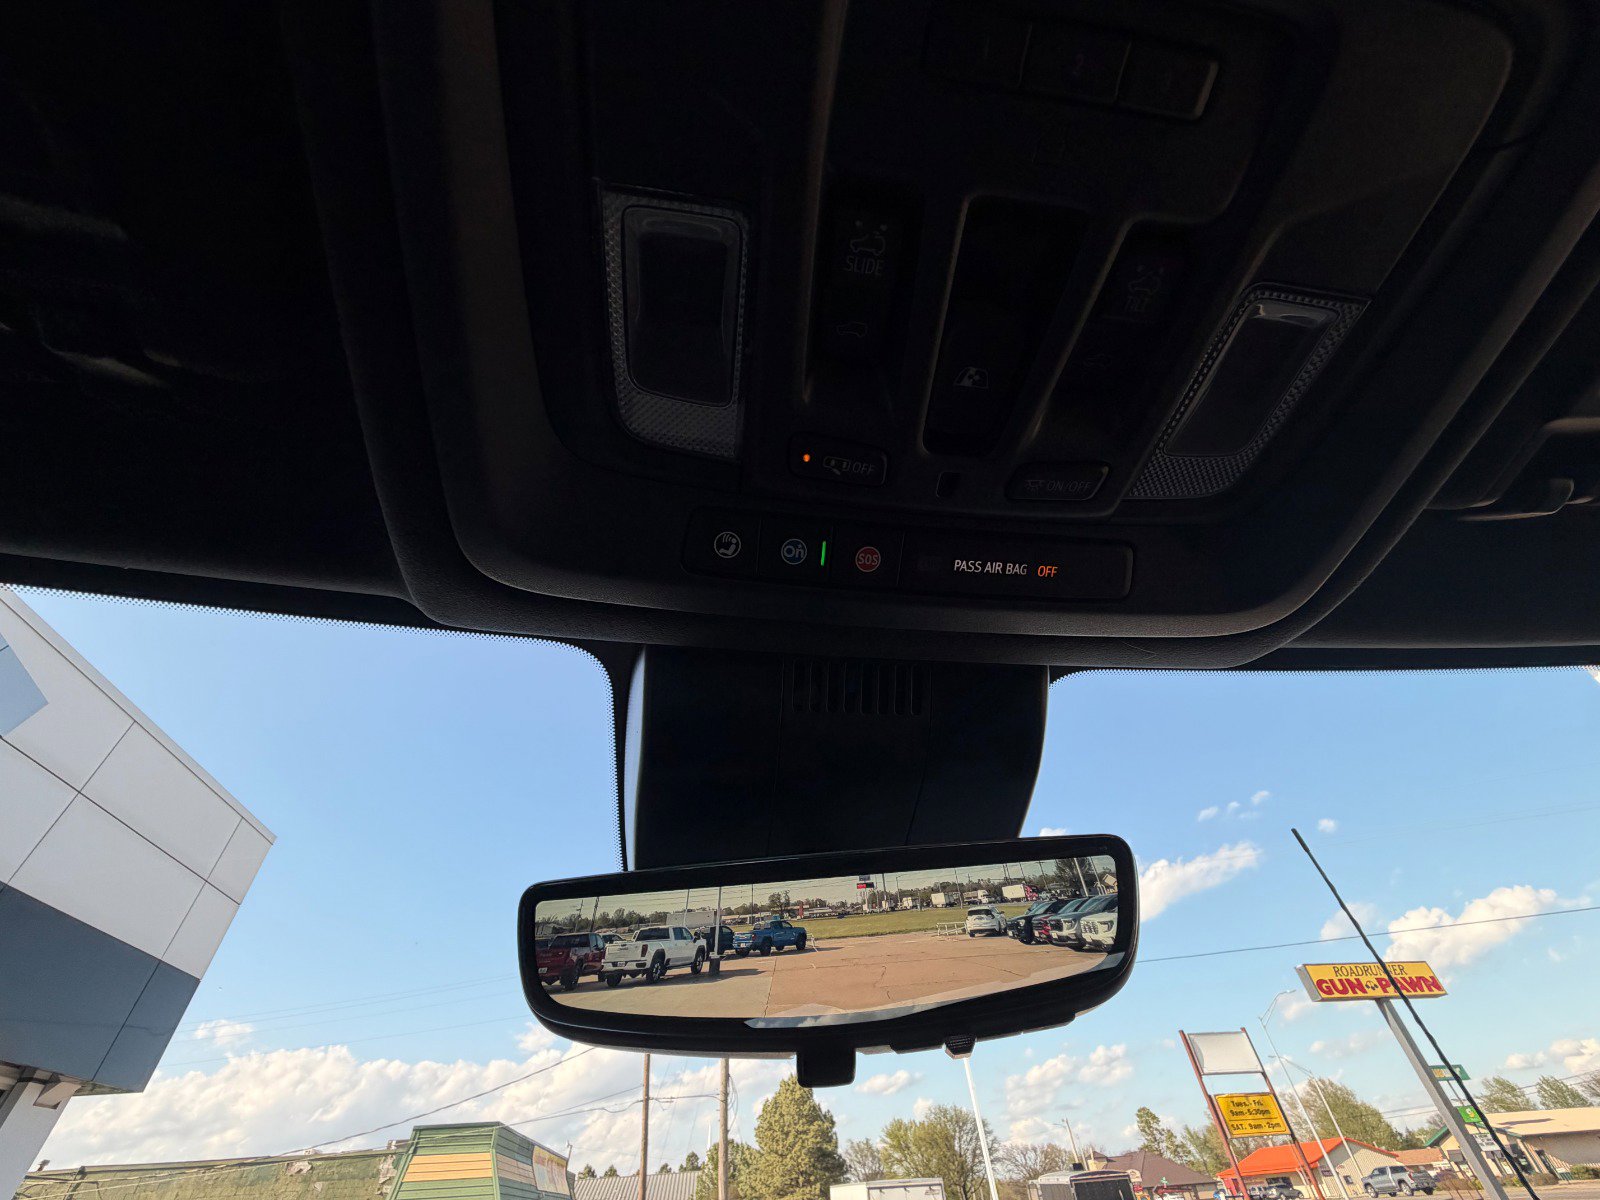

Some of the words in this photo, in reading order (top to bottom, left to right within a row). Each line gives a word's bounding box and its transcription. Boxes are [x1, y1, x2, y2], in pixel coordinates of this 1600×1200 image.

[845, 255, 885, 276] SLIDE
[858, 553, 878, 566] SOS
[953, 559, 982, 572] PASS
[984, 561, 1003, 574] AIR
[1005, 563, 1028, 576] BAG
[1037, 565, 1058, 578] OFF
[1315, 977, 1368, 996] GUN
[1375, 975, 1443, 994] PAWN
